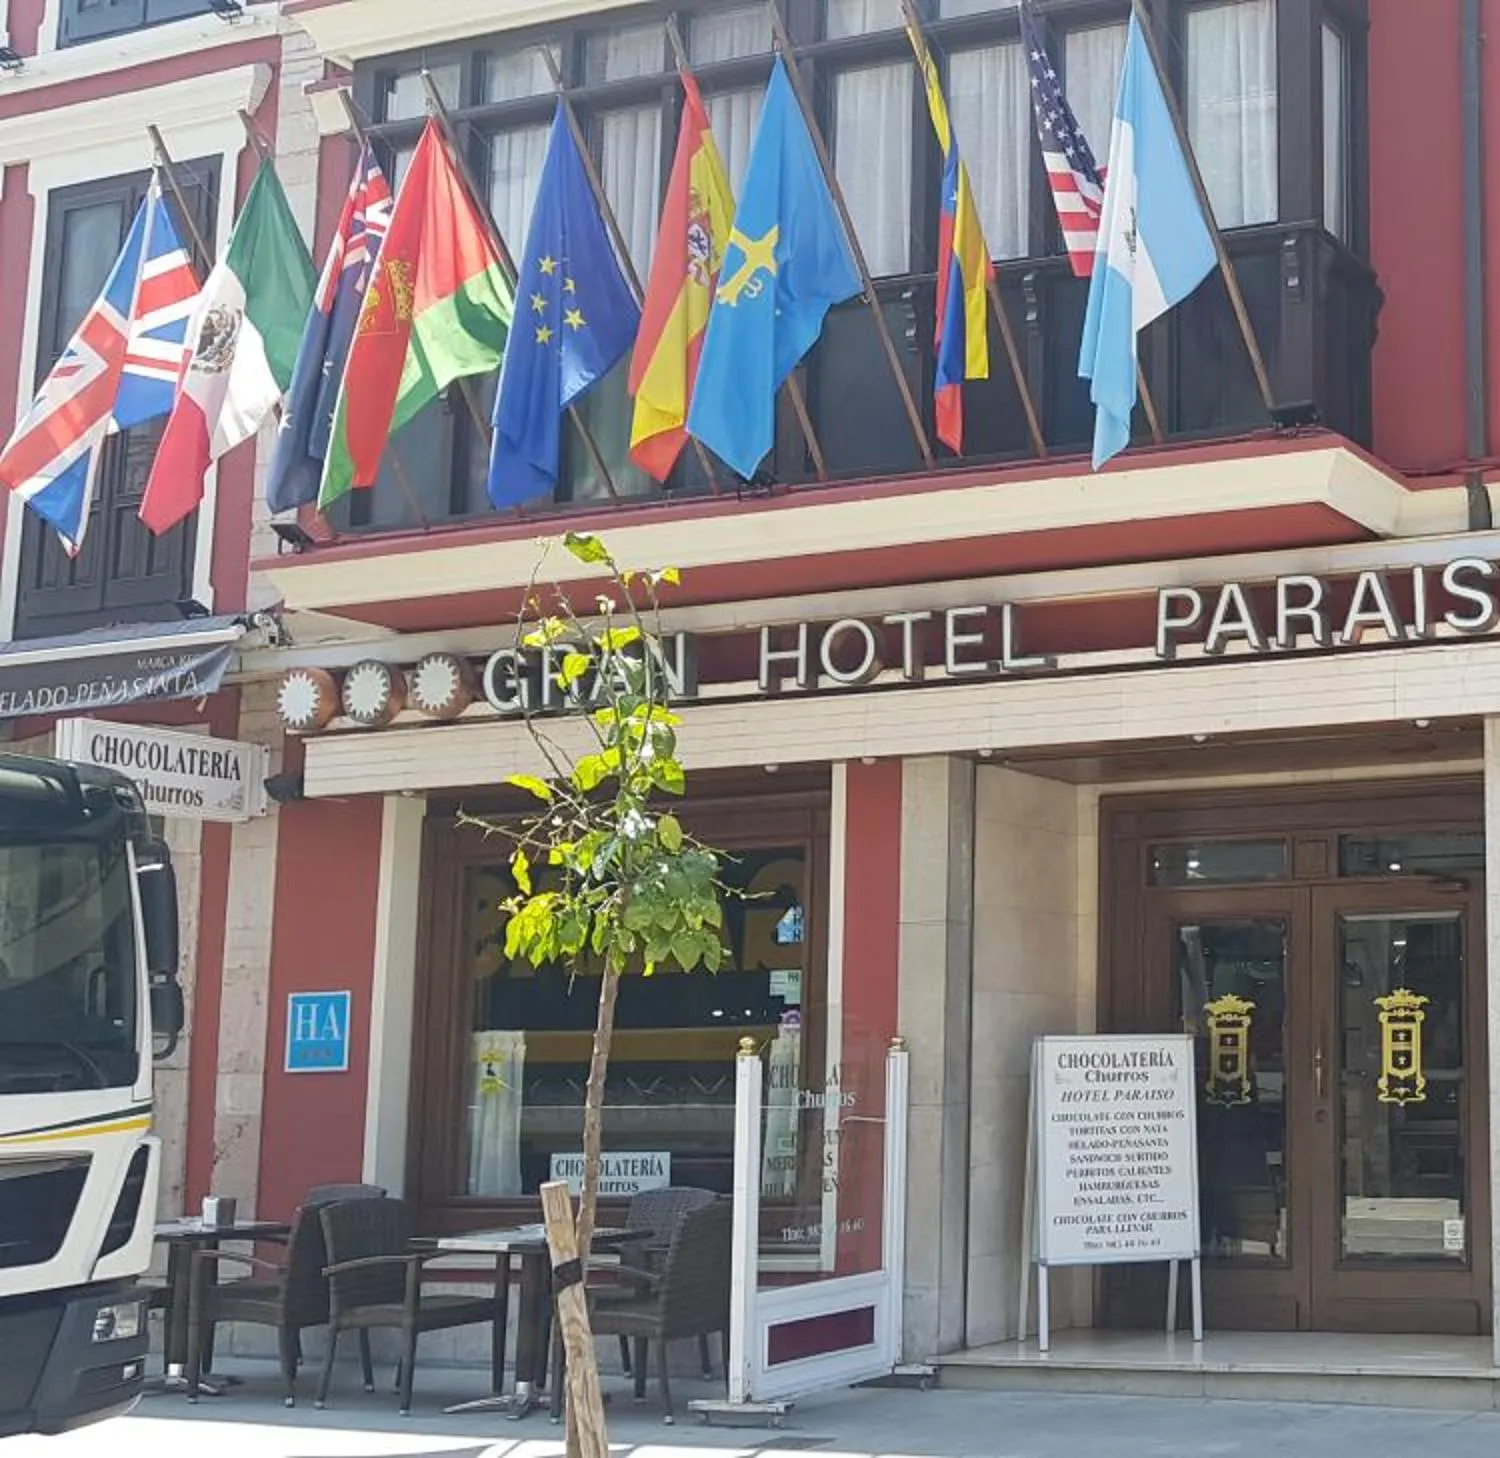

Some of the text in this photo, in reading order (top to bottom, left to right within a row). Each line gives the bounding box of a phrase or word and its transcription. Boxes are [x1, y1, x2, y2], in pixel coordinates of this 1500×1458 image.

[483, 631, 690, 713] GRAN
[759, 601, 1048, 691] HOTEL
[91, 733, 241, 781] CHOCOLATERÍA
[295, 1003, 342, 1041] HA
[1058, 1048, 1175, 1069] CHOCOLATERÍA
[1085, 1069, 1149, 1083] Churros
[1061, 1088, 1175, 1103] HOTEL PARAISO
[1113, 1111, 1136, 1121] CON
